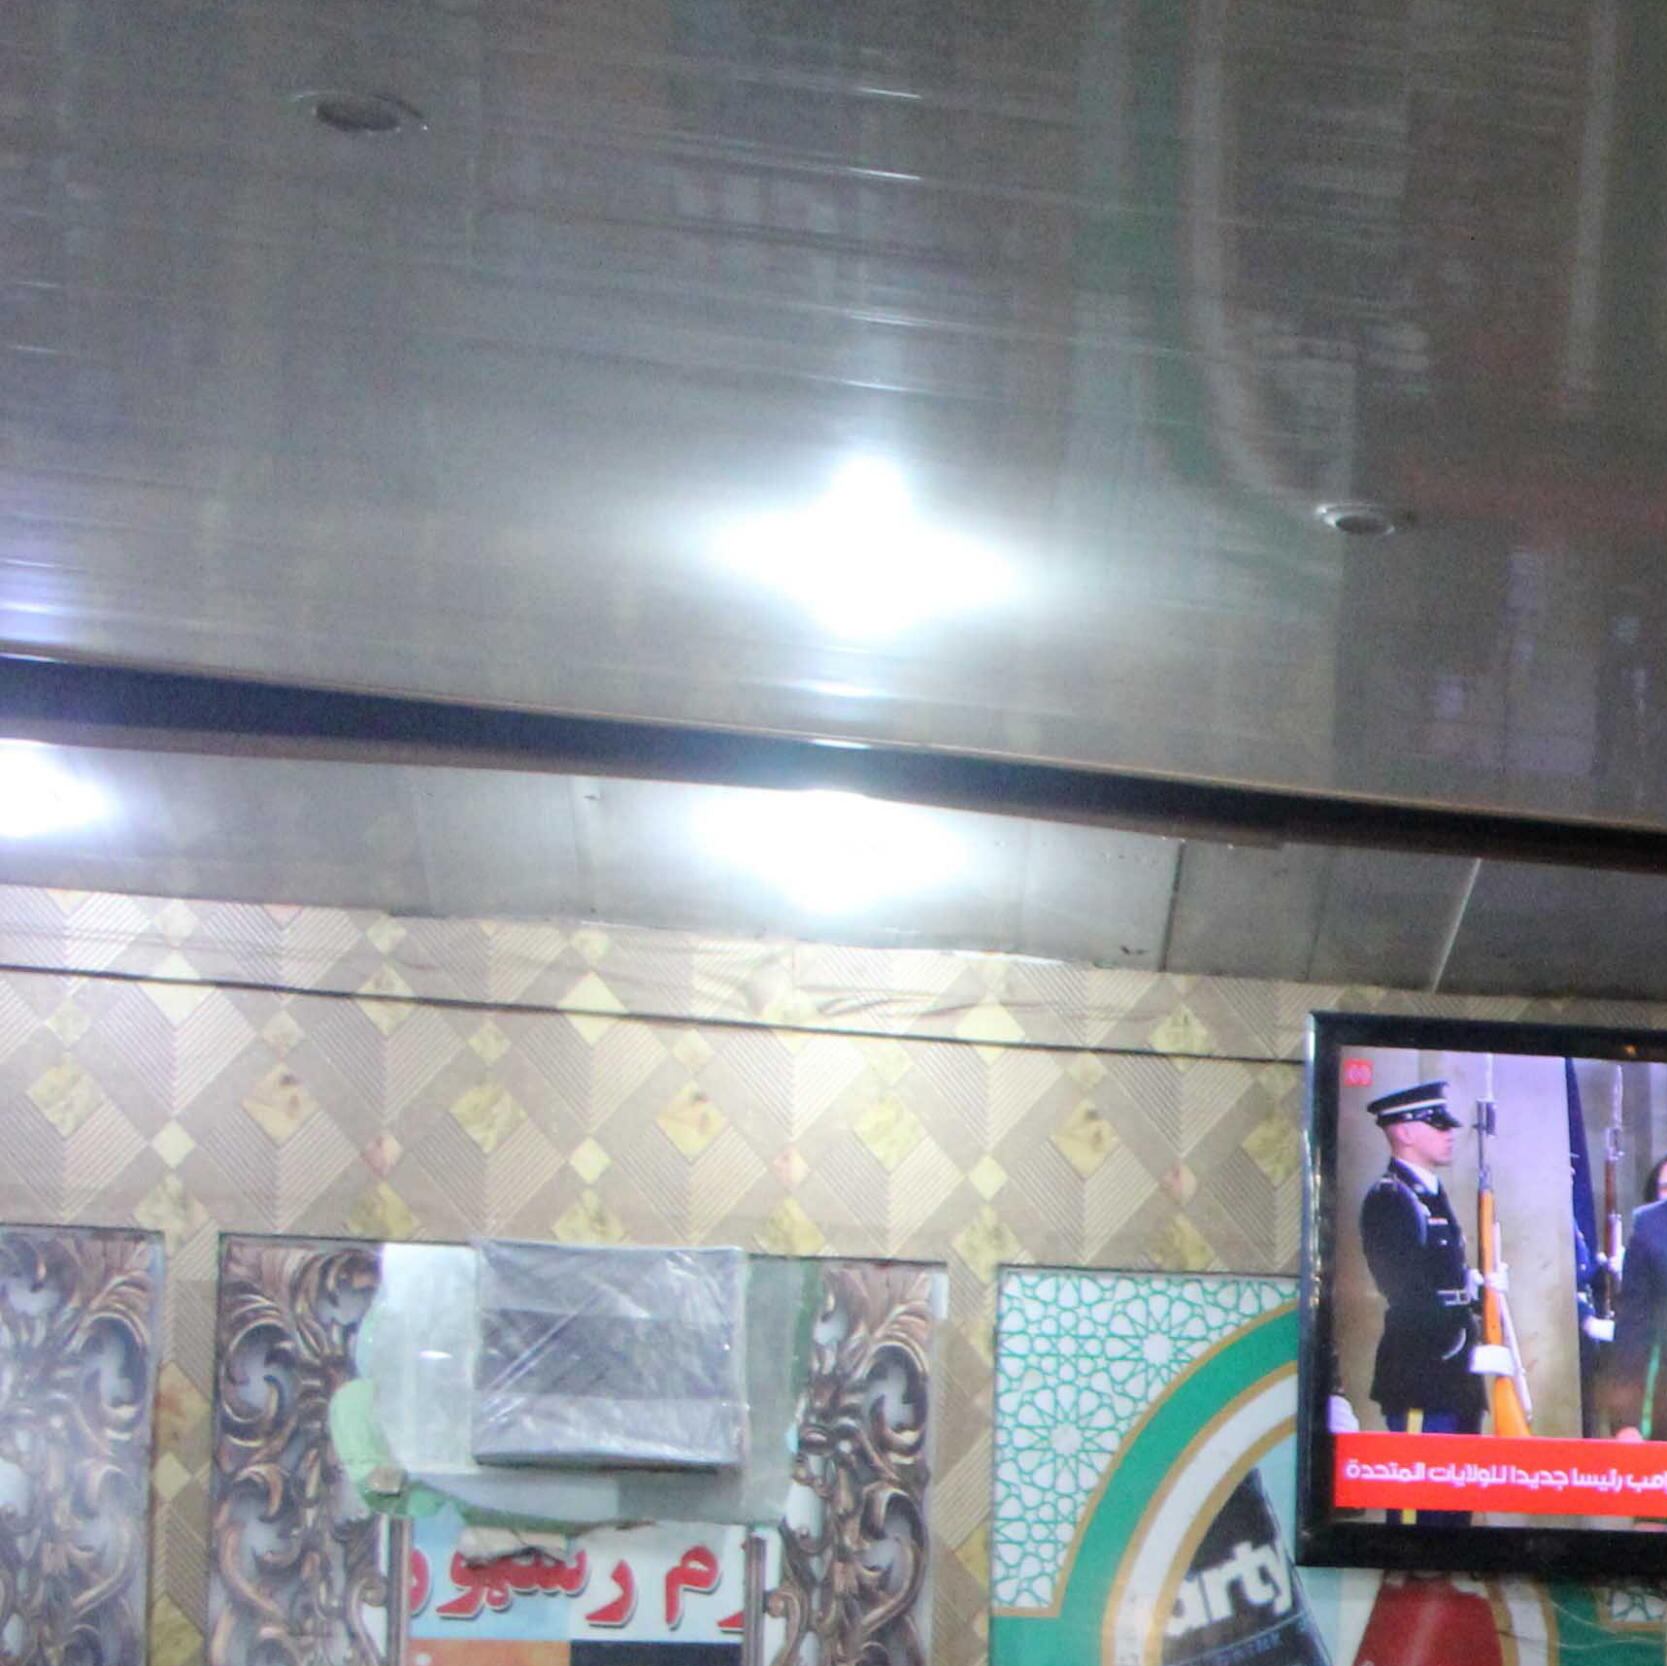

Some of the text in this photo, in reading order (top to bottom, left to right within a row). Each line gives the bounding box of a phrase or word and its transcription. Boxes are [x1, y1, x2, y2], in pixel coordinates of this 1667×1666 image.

[1344, 1458, 1426, 1482] المتحدة
[1428, 1462, 1507, 1488] للولايات
[1510, 1466, 1569, 1491] جديدا
[1163, 1540, 1294, 1638] arty
